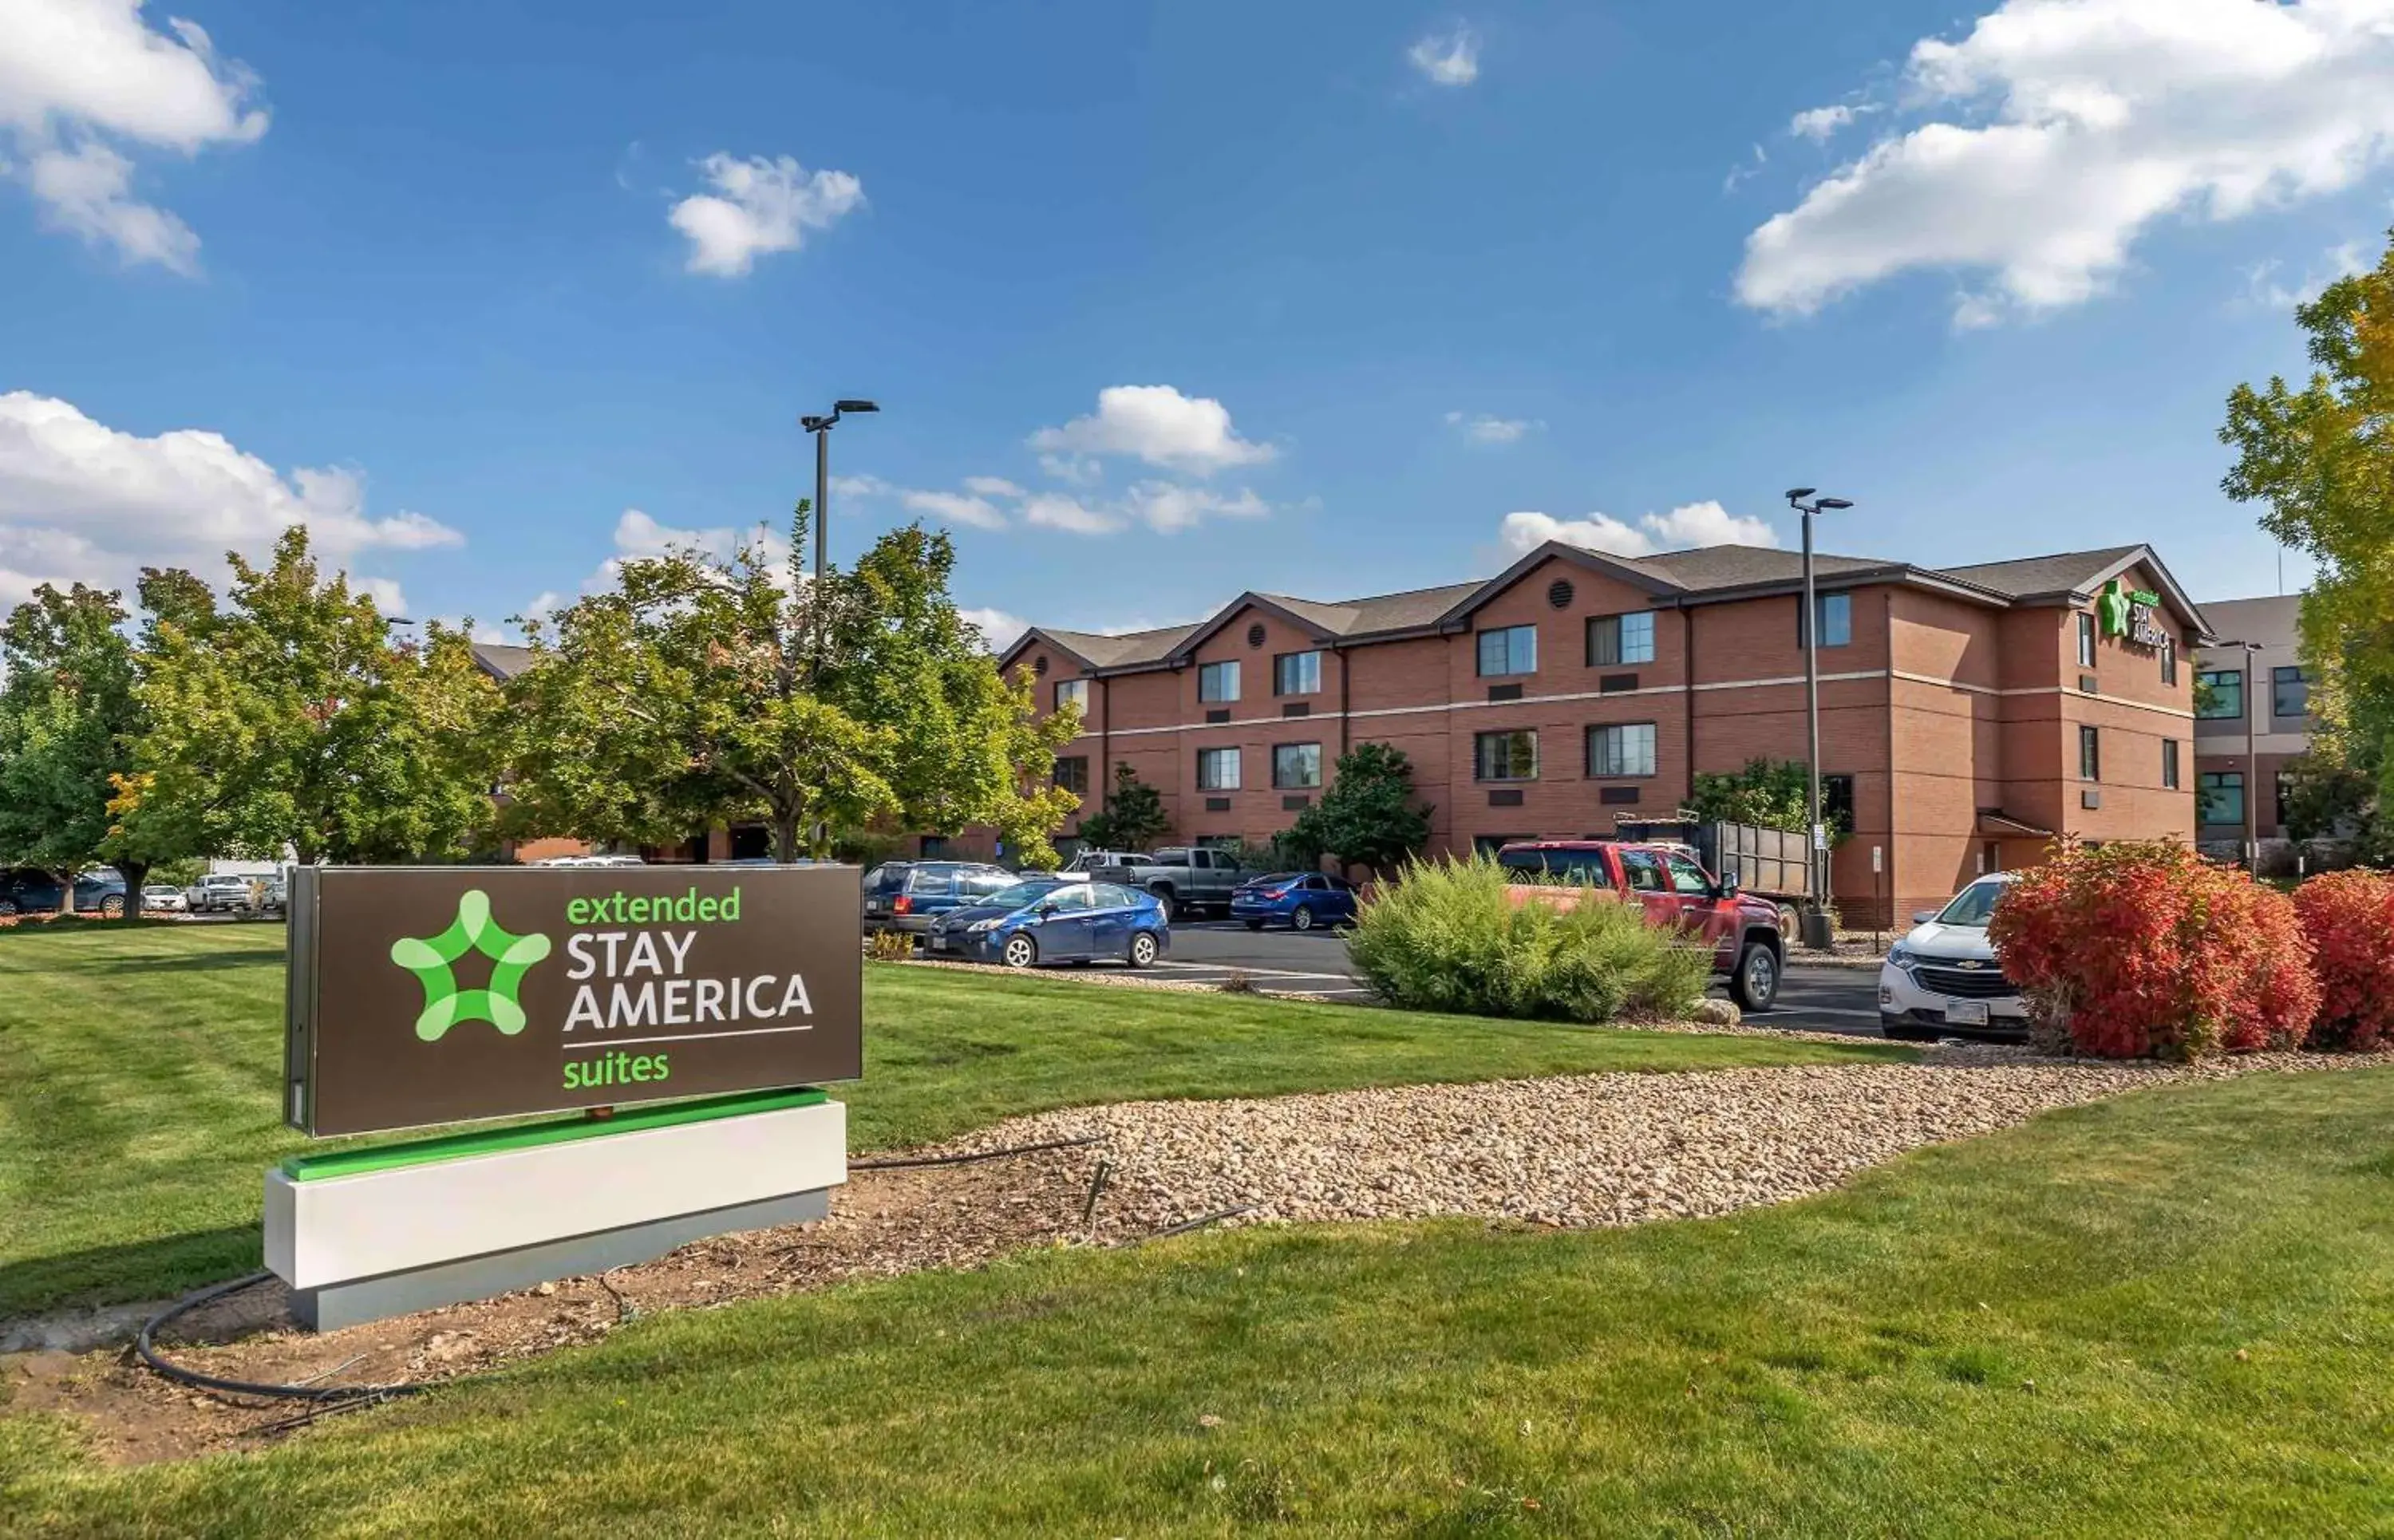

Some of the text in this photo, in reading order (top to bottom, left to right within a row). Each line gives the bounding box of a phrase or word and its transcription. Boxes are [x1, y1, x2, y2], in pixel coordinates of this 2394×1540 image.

[567, 886, 741, 924] extended
[566, 931, 697, 980] STAY
[562, 974, 813, 1031] AMERICA
[563, 1051, 669, 1088] suites
